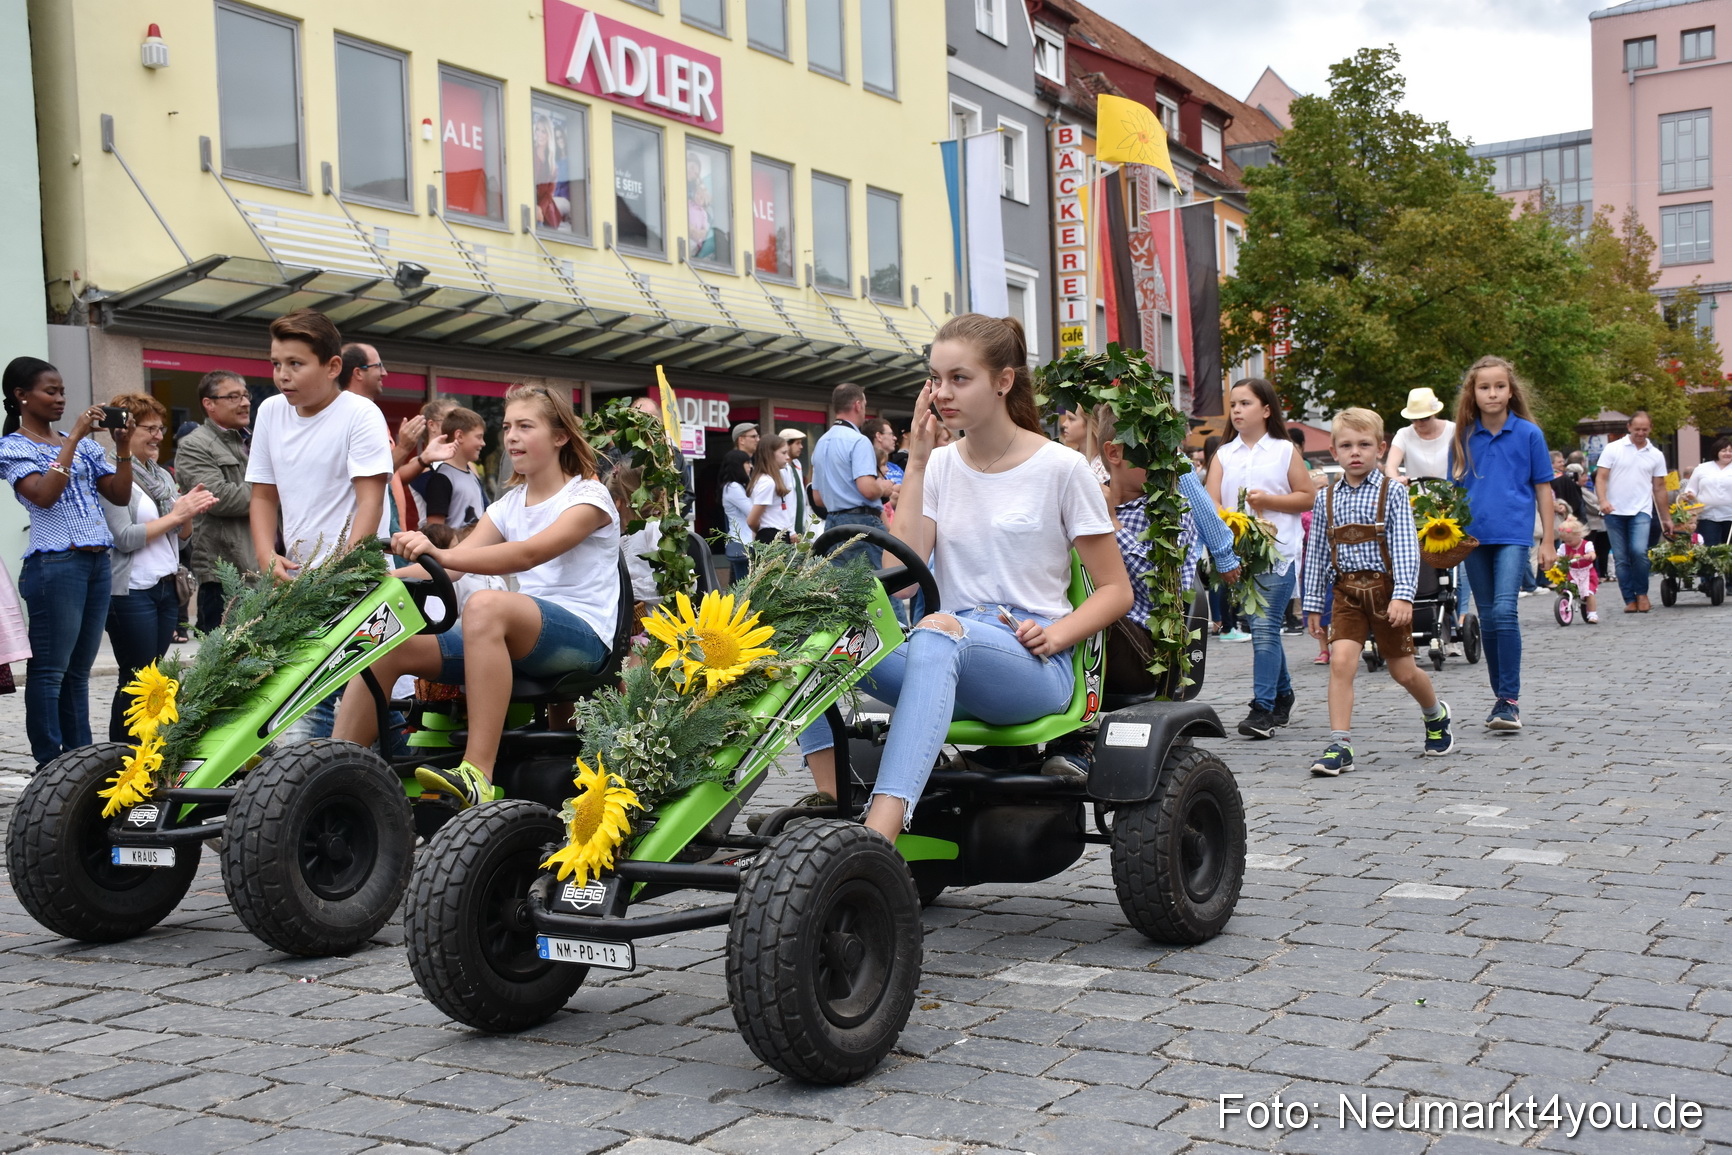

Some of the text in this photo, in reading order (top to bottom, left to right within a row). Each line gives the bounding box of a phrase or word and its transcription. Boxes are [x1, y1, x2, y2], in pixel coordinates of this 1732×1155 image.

[565, 11, 718, 122] ADLER
[622, 178, 643, 194] SEITE
[1058, 128, 1077, 319] BÄCKEREI
[1061, 328, 1083, 344] café
[132, 850, 158, 863] KRAUS
[564, 887, 603, 900] BERG
